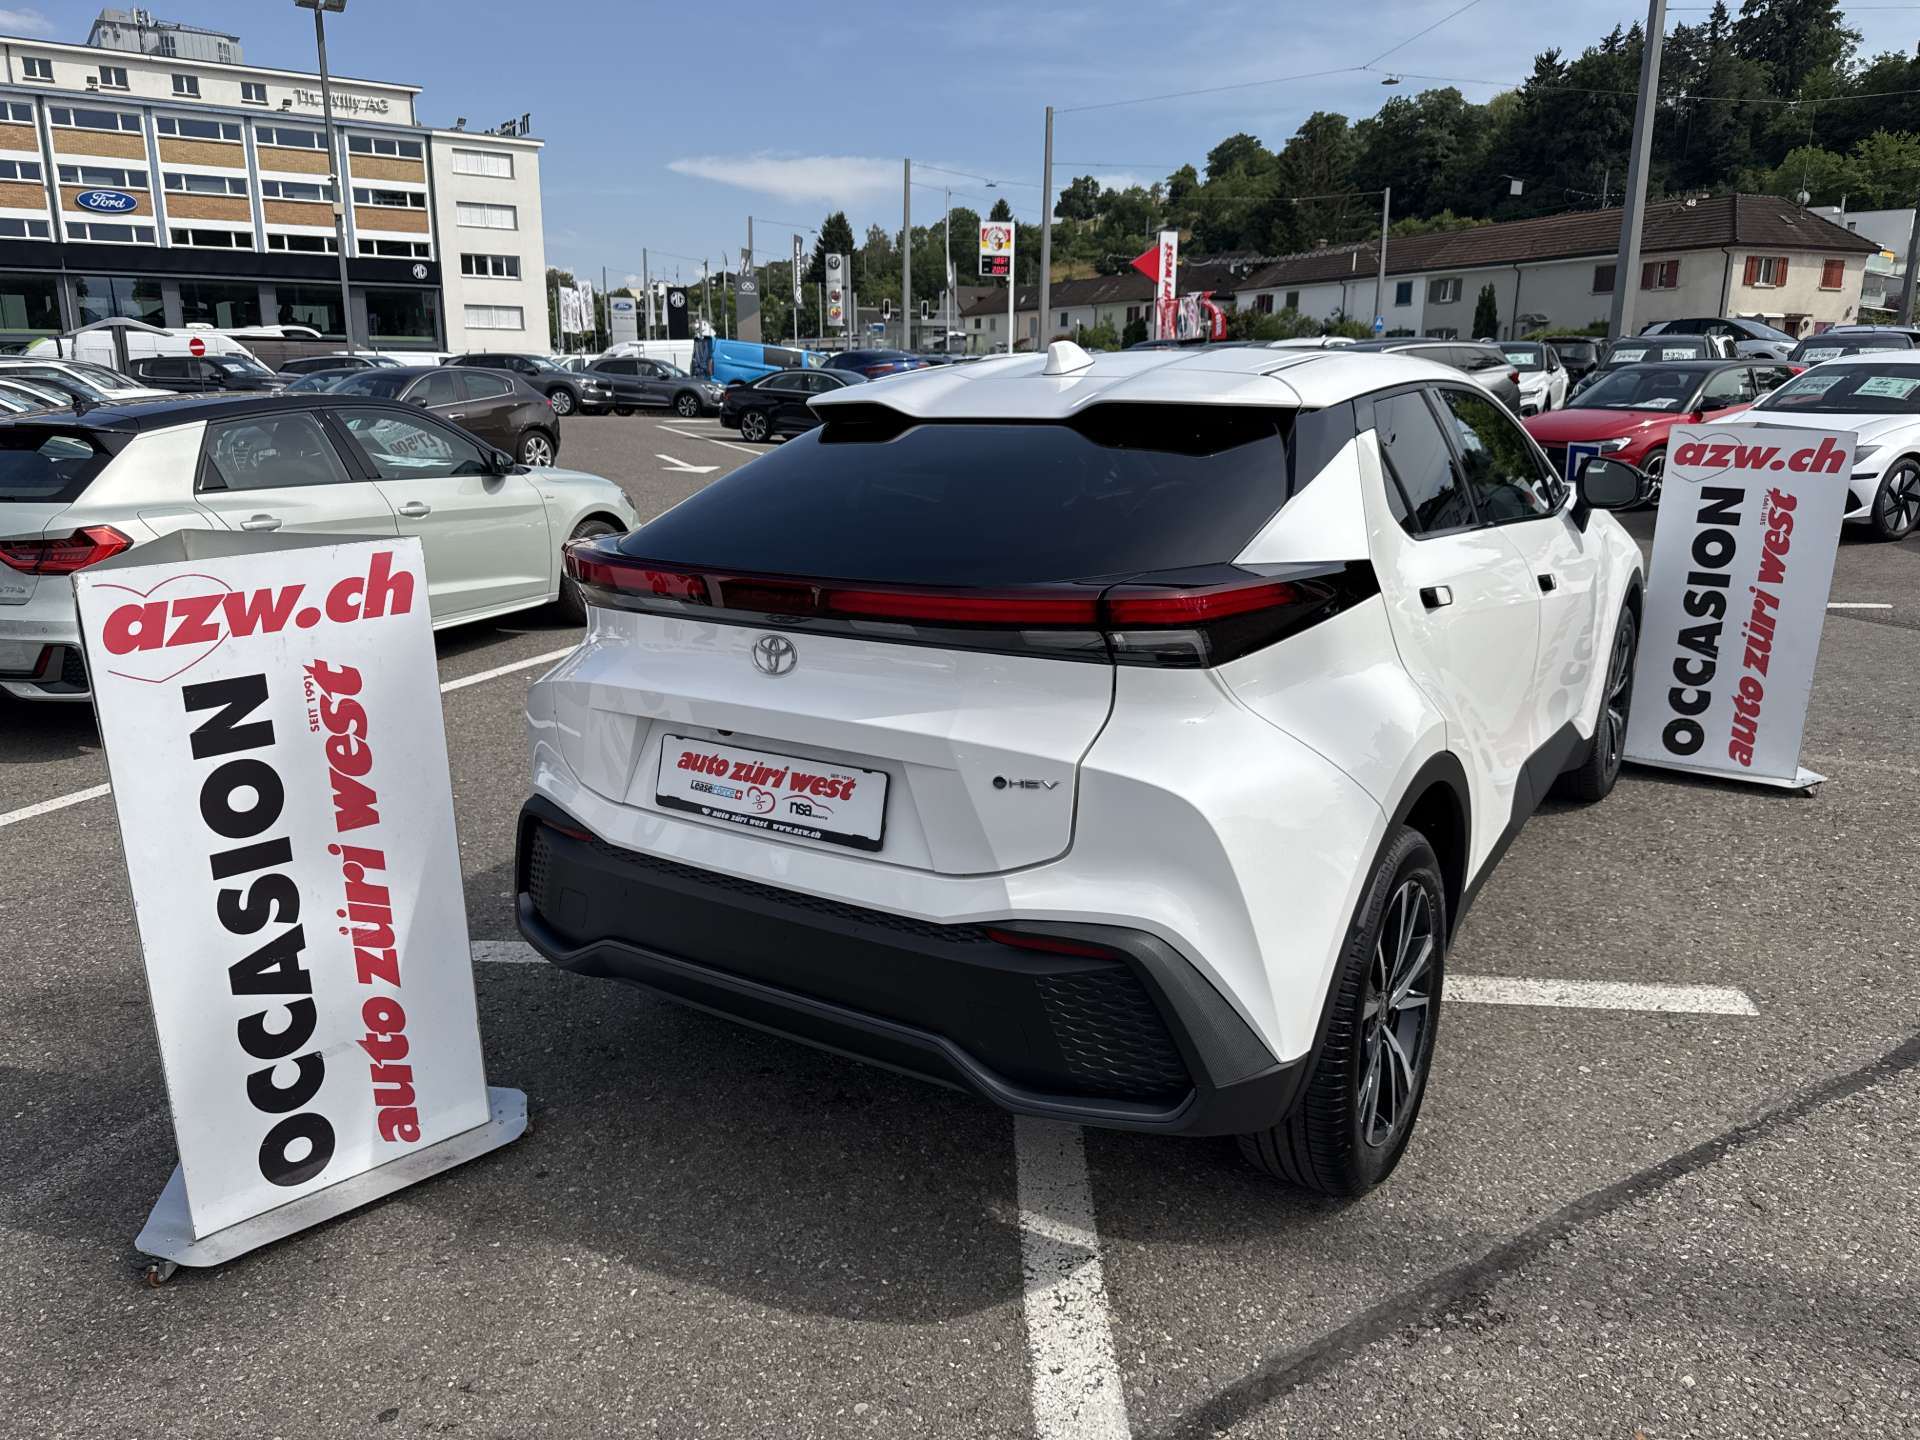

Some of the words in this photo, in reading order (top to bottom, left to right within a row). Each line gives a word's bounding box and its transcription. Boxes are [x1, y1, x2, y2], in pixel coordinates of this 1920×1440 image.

[367, 96, 389, 111] AG
[89, 192, 126, 208] Ford
[1686, 198, 1697, 207] 48
[670, 291, 685, 308] MG
[1673, 438, 1847, 474] azw.ch
[1757, 487, 1798, 584] west
[102, 551, 414, 654] azw.ch
[1662, 486, 1745, 756] OCCASION
[1741, 585, 1780, 678] züri
[304, 674, 316, 703] 1991
[308, 707, 320, 732] SEIT
[1728, 675, 1764, 767] auto
[302, 659, 381, 833] west
[677, 751, 730, 777] auto
[728, 761, 790, 788] züri
[789, 771, 857, 801] west
[1009, 780, 1060, 790] HEV
[712, 810, 730, 820] auto
[730, 814, 748, 824] züri
[749, 818, 769, 828] west
[772, 822, 822, 839] www.azw.ch
[789, 801, 813, 817] nsa
[182, 672, 336, 1188] OCCASION
[328, 843, 402, 988] züri
[356, 995, 422, 1143] auto
